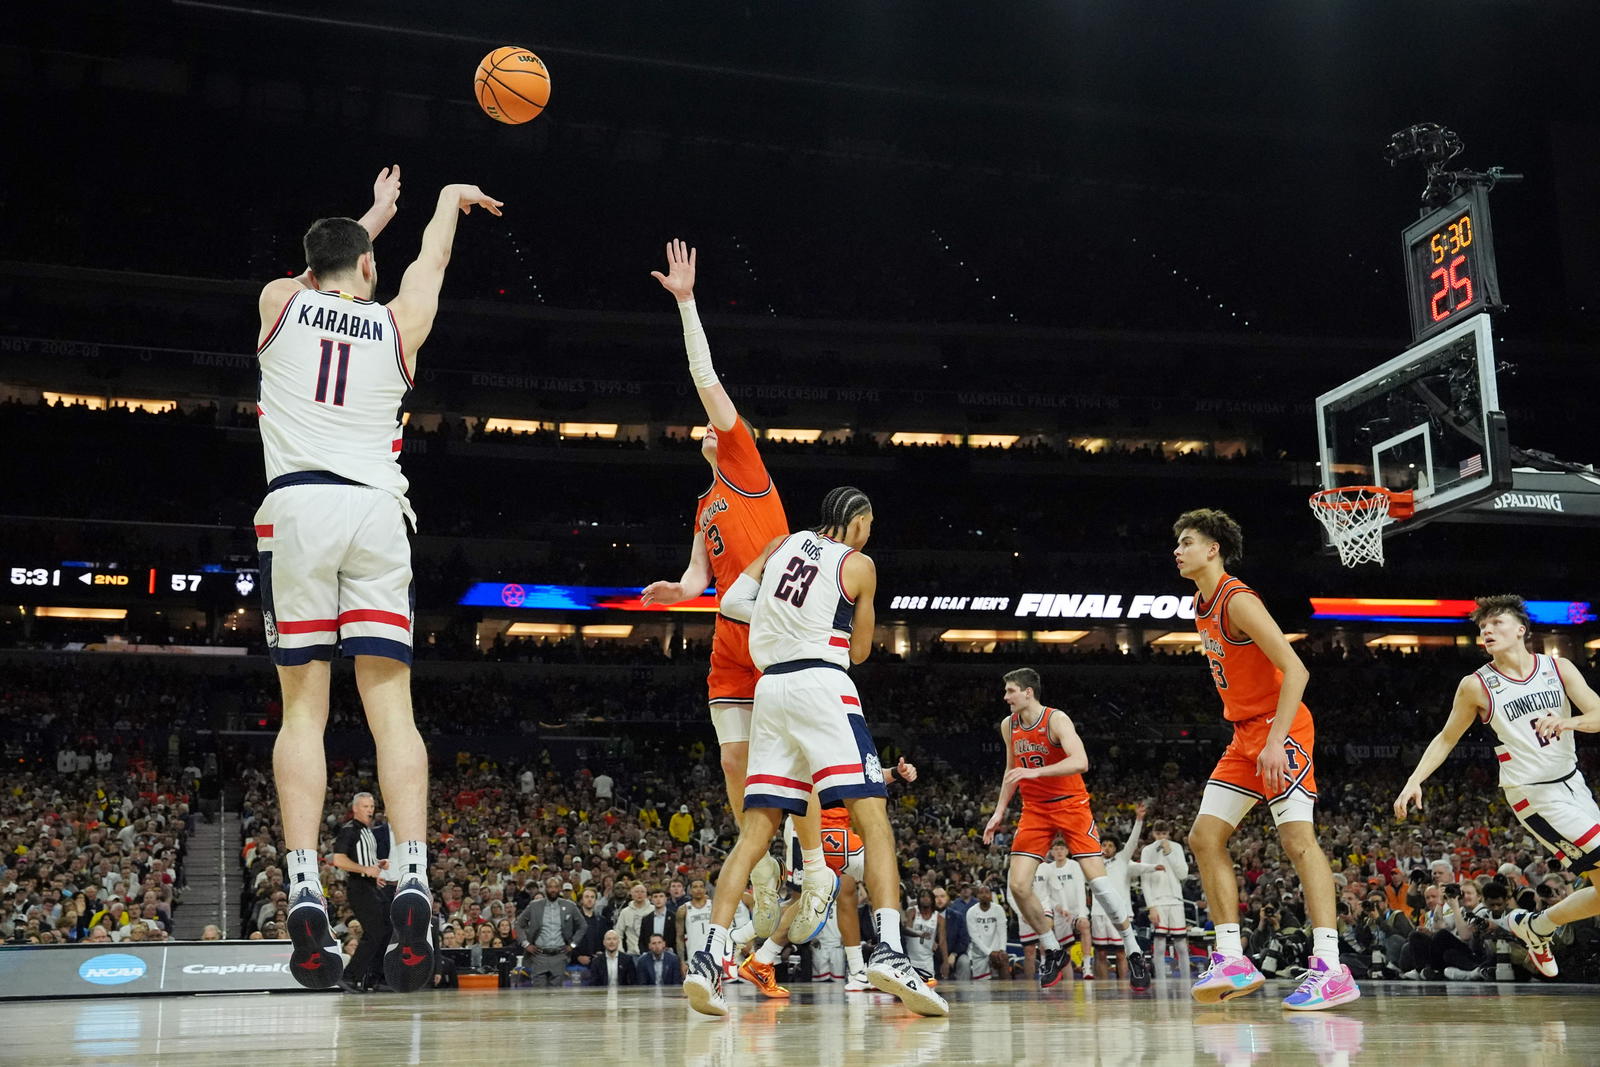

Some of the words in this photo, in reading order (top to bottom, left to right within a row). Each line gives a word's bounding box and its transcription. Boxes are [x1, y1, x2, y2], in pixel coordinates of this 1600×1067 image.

[1430, 216, 1472, 264] 5:30
[1430, 255, 1473, 321] 25
[298, 304, 383, 341] KARABAN
[192, 352, 250, 369] MARVIN
[314, 338, 352, 406] 11
[541, 377, 586, 393] JAMES
[728, 385, 754, 399] RIC
[957, 392, 1024, 406] MARSHALL
[1494, 492, 1564, 512] SPALDING
[707, 524, 725, 556] 3
[10, 567, 61, 586] 5:31
[94, 574, 129, 586] 2ND
[171, 574, 202, 592] 57
[774, 556, 819, 608] 23
[890, 596, 929, 610] 2026
[1014, 593, 1124, 617] FINAL
[1127, 596, 1197, 619] FOU
[1503, 690, 1562, 722] CONNECTICUT
[86, 967, 145, 979] NCAA
[182, 963, 281, 976] Capital
